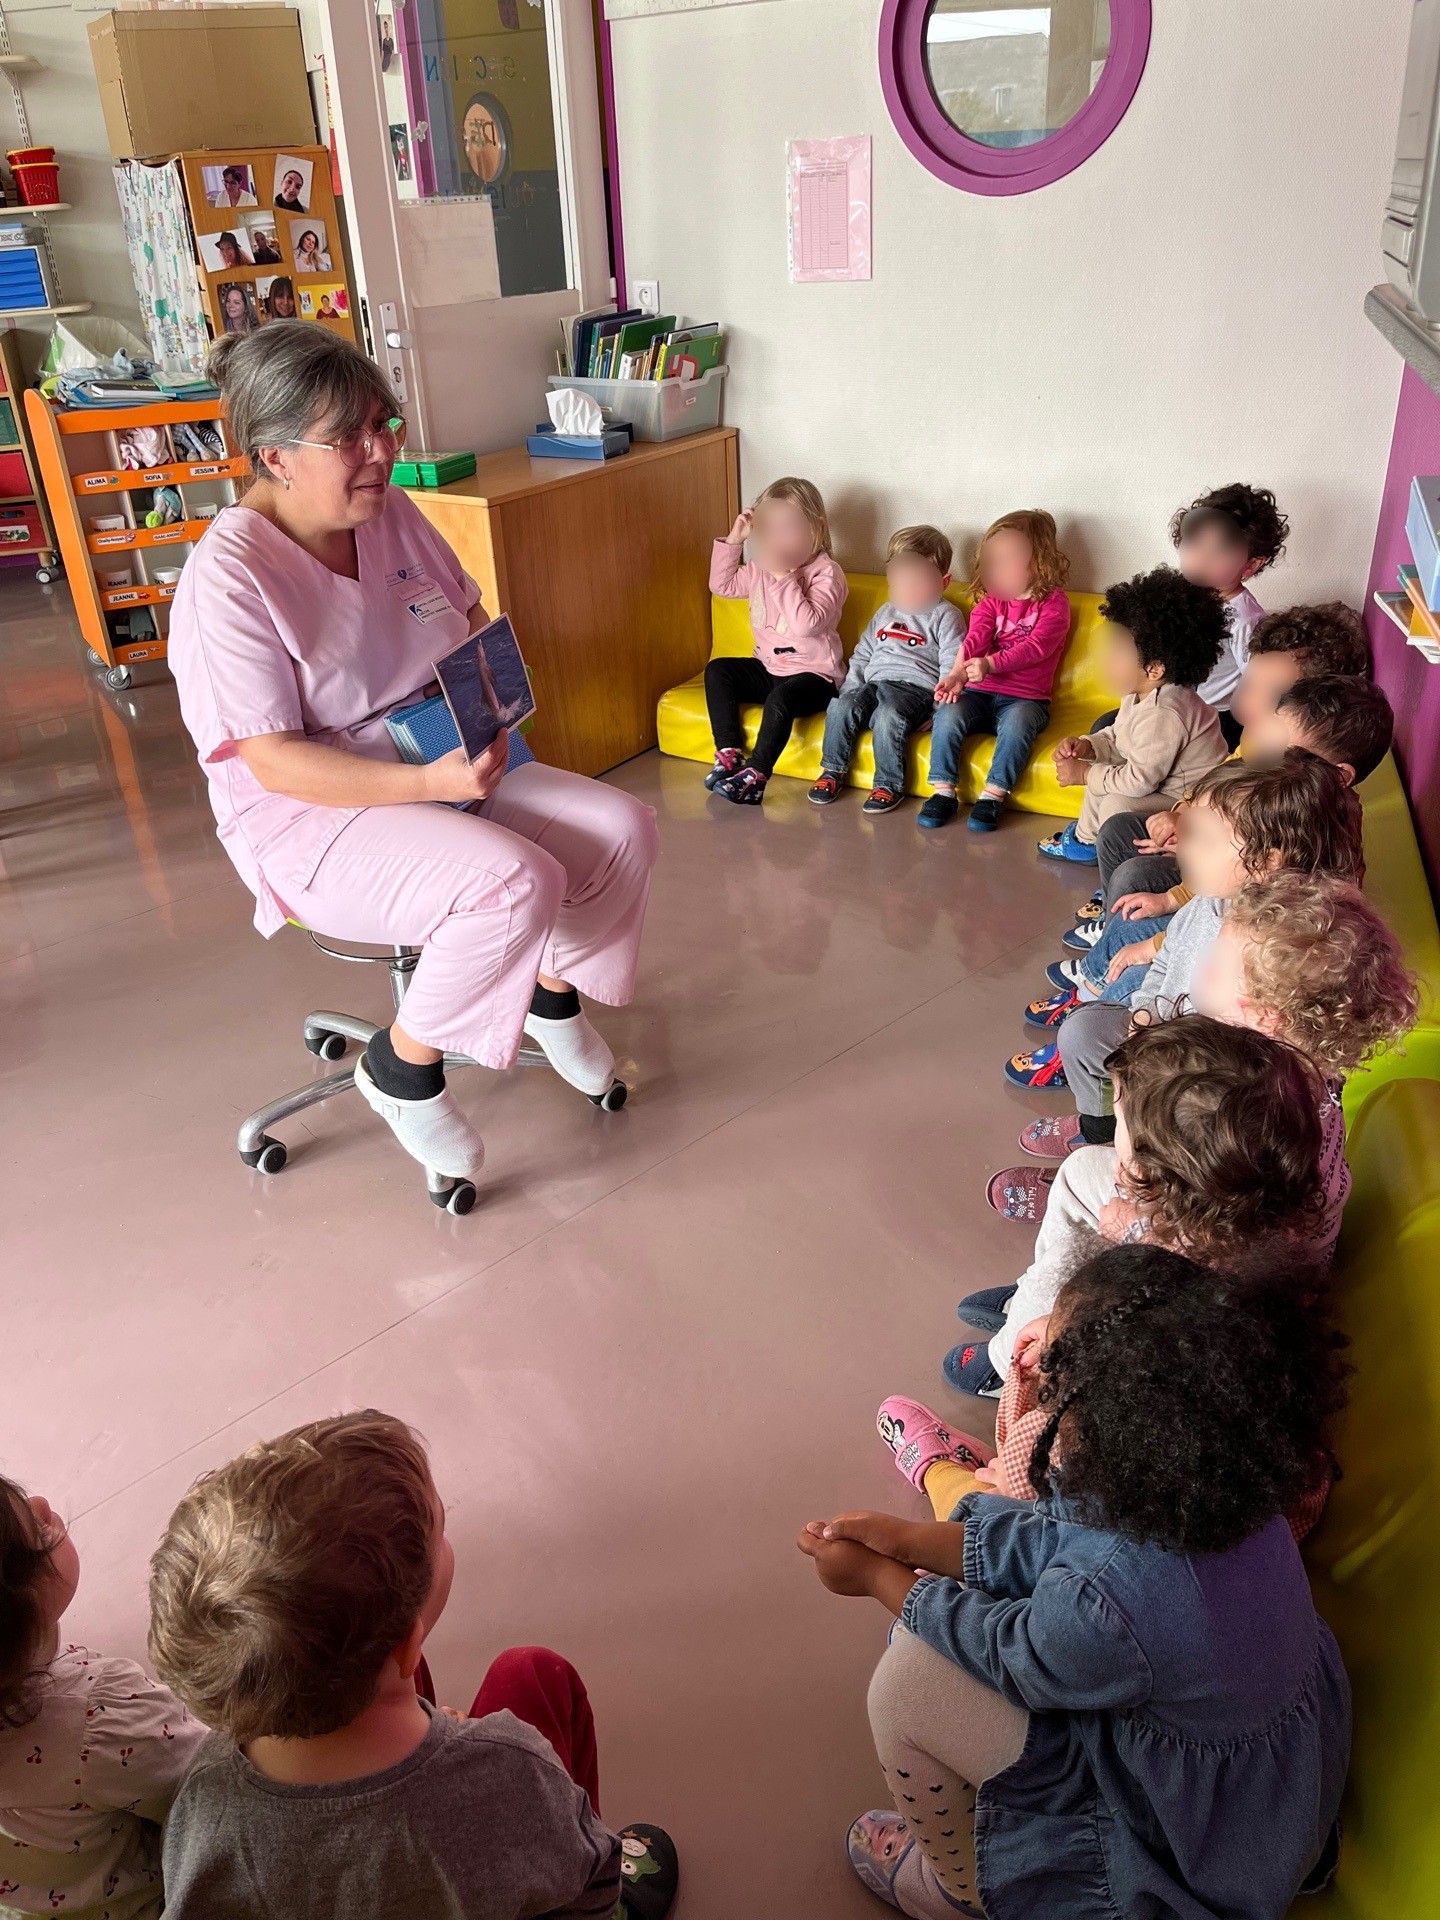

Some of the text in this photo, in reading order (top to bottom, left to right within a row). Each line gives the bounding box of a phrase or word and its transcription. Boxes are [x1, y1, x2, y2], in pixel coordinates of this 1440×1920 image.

[87, 478, 106, 486] ALIMA
[113, 593, 135, 602] JEANNE
[129, 651, 148, 659] LAURA
